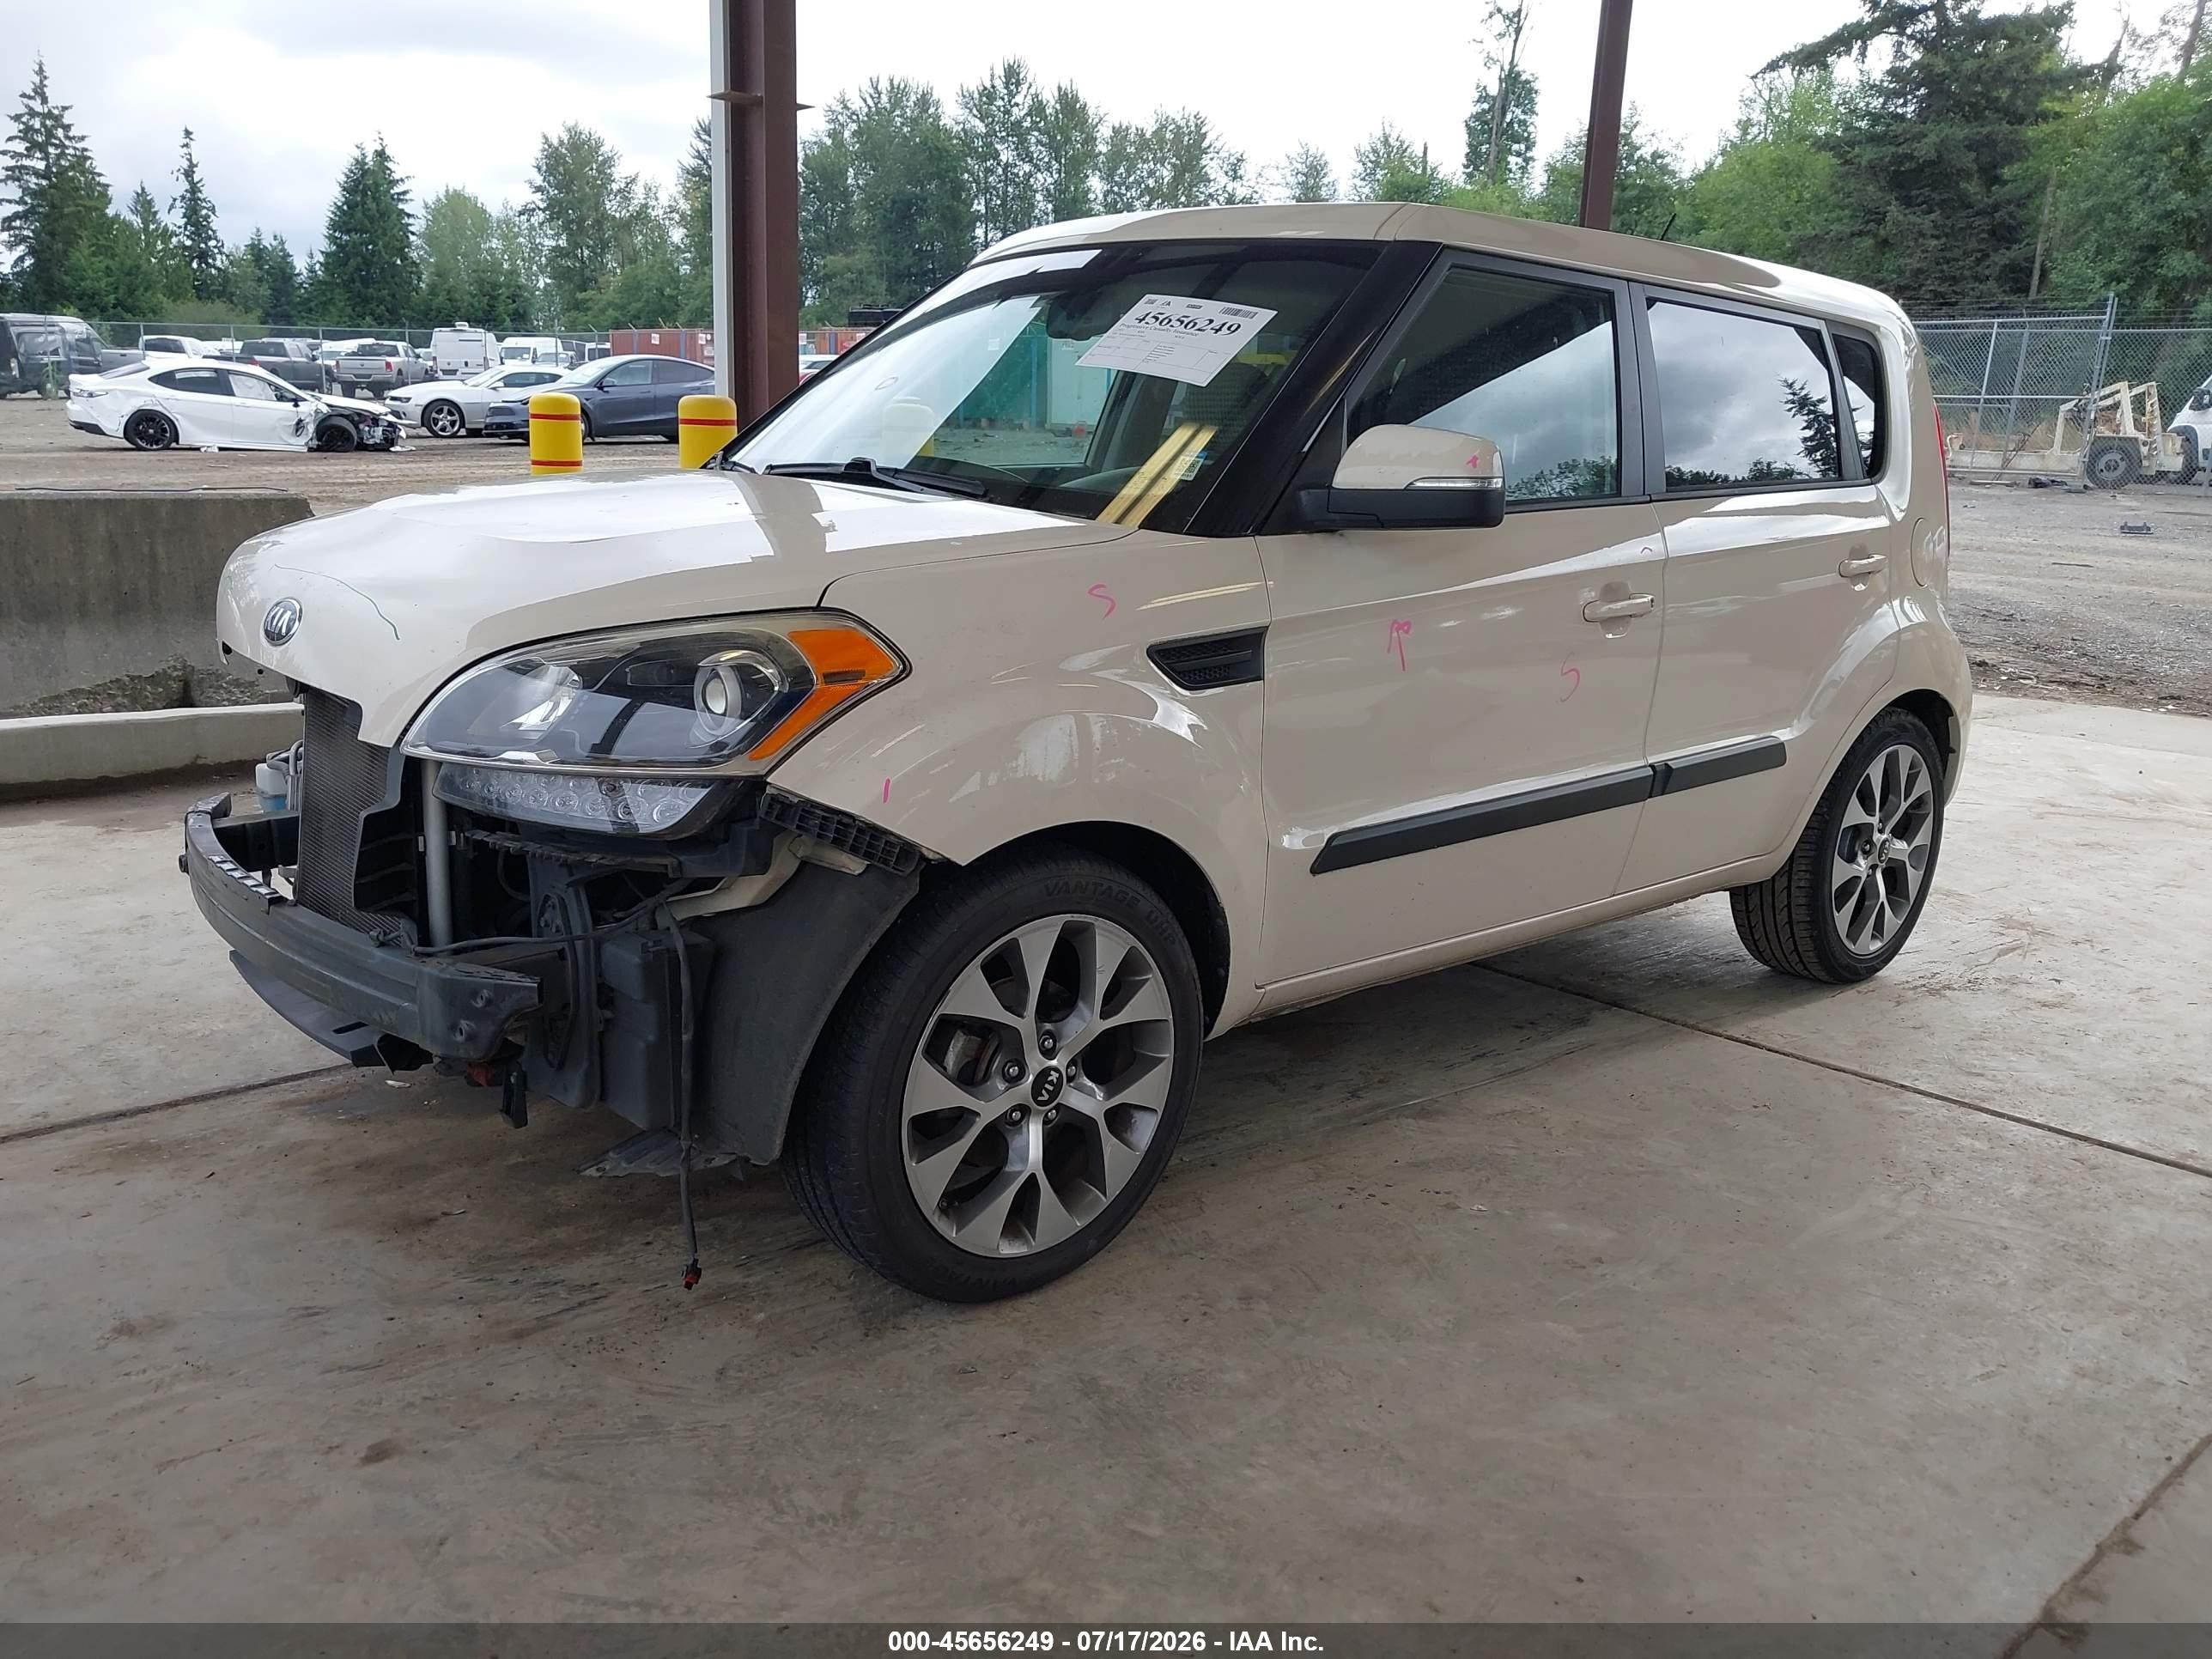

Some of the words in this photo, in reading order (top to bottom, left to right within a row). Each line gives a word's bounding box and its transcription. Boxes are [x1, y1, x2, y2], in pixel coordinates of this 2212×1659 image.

[1134, 311, 1242, 336] 45656249
[1043, 880, 1141, 908] VANTAGE
[1036, 1070, 1060, 1101] KIA
